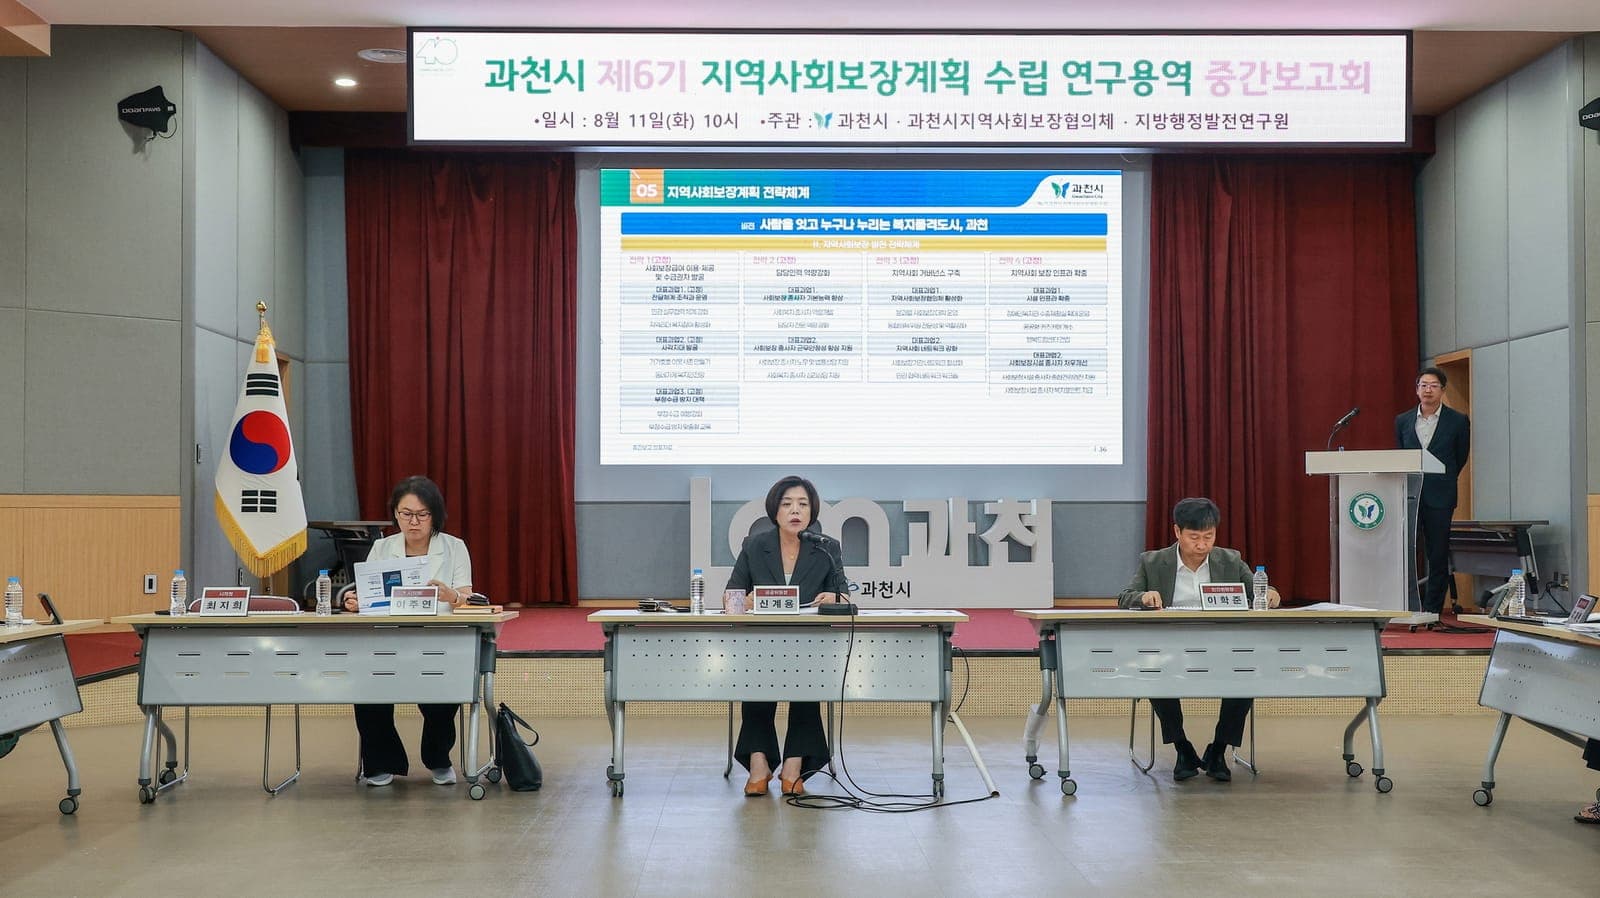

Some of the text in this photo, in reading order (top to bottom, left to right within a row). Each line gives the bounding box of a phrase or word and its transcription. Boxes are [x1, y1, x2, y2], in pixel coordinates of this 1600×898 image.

[484, 56, 1372, 97] 과천시 제6기 지역사회보장계획 수립 연구용역 중간보고회
[593, 111, 620, 130] 8월
[628, 111, 695, 130] 11일(화)
[704, 111, 740, 130] 10시
[837, 111, 889, 130] 과천시
[907, 112, 1114, 131] 과천시지역사회보장협의체
[1135, 112, 1290, 131] 지방행정발전연구원
[636, 184, 810, 200] 05 지역사회보장계획 전략체계
[1072, 184, 1104, 194] 과천시
[760, 219, 793, 233] 사람을
[796, 219, 818, 233] 잇고
[821, 219, 854, 233] 누구나
[857, 219, 890, 233] 누리는
[966, 219, 988, 233] 과천
[861, 580, 912, 599] 과천시
